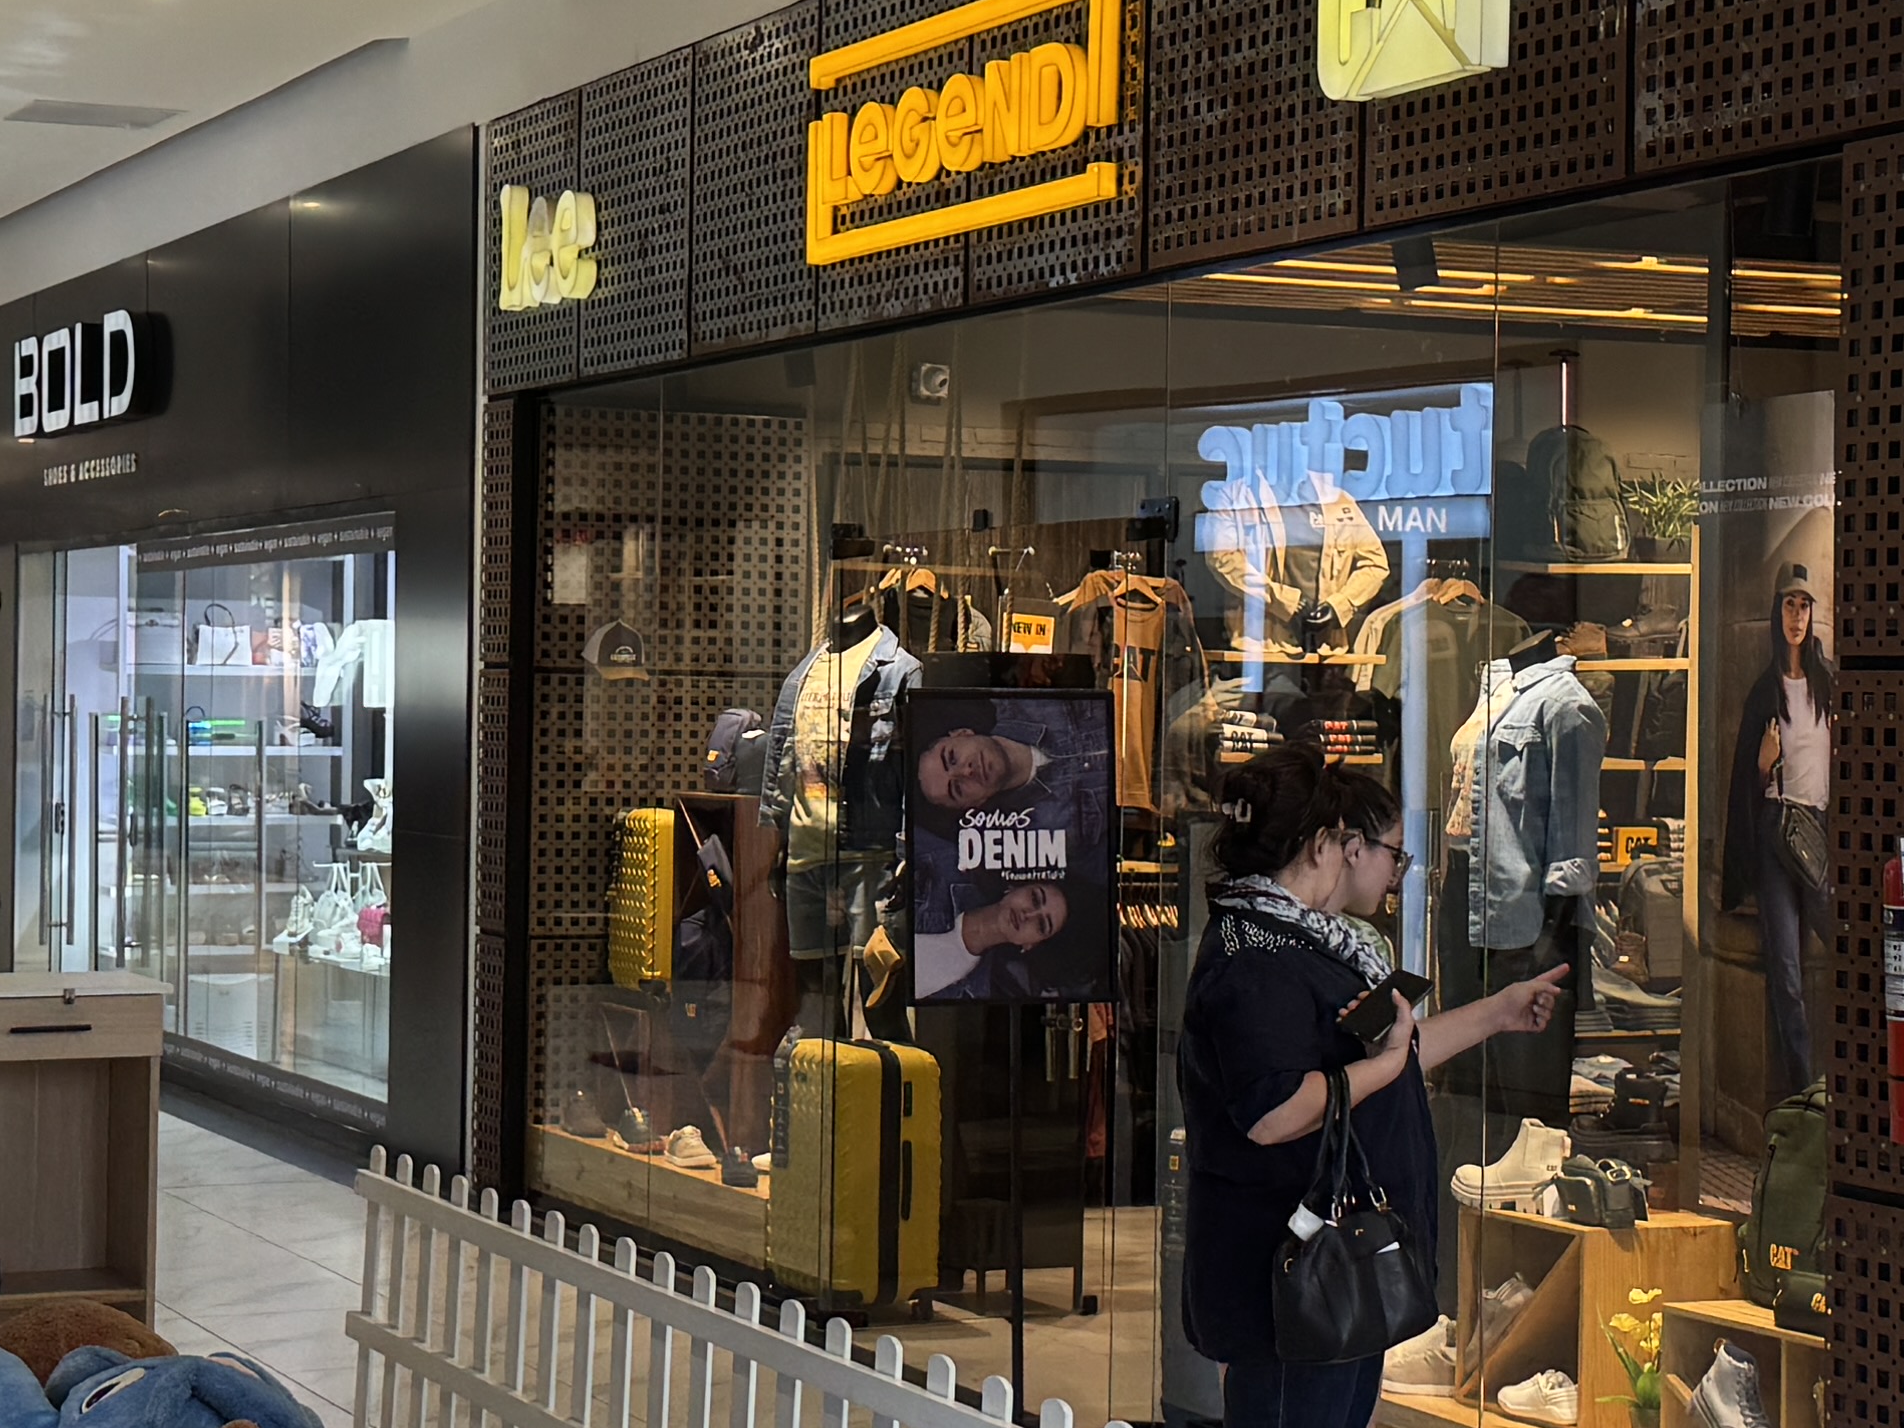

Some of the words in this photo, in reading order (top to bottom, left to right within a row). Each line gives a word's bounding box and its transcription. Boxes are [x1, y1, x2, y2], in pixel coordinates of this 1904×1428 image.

[14, 309, 136, 437] BOLD
[1377, 504, 1447, 533] MAN
[958, 828, 1067, 871] DENIM
[1770, 1243, 1800, 1270] CAT
